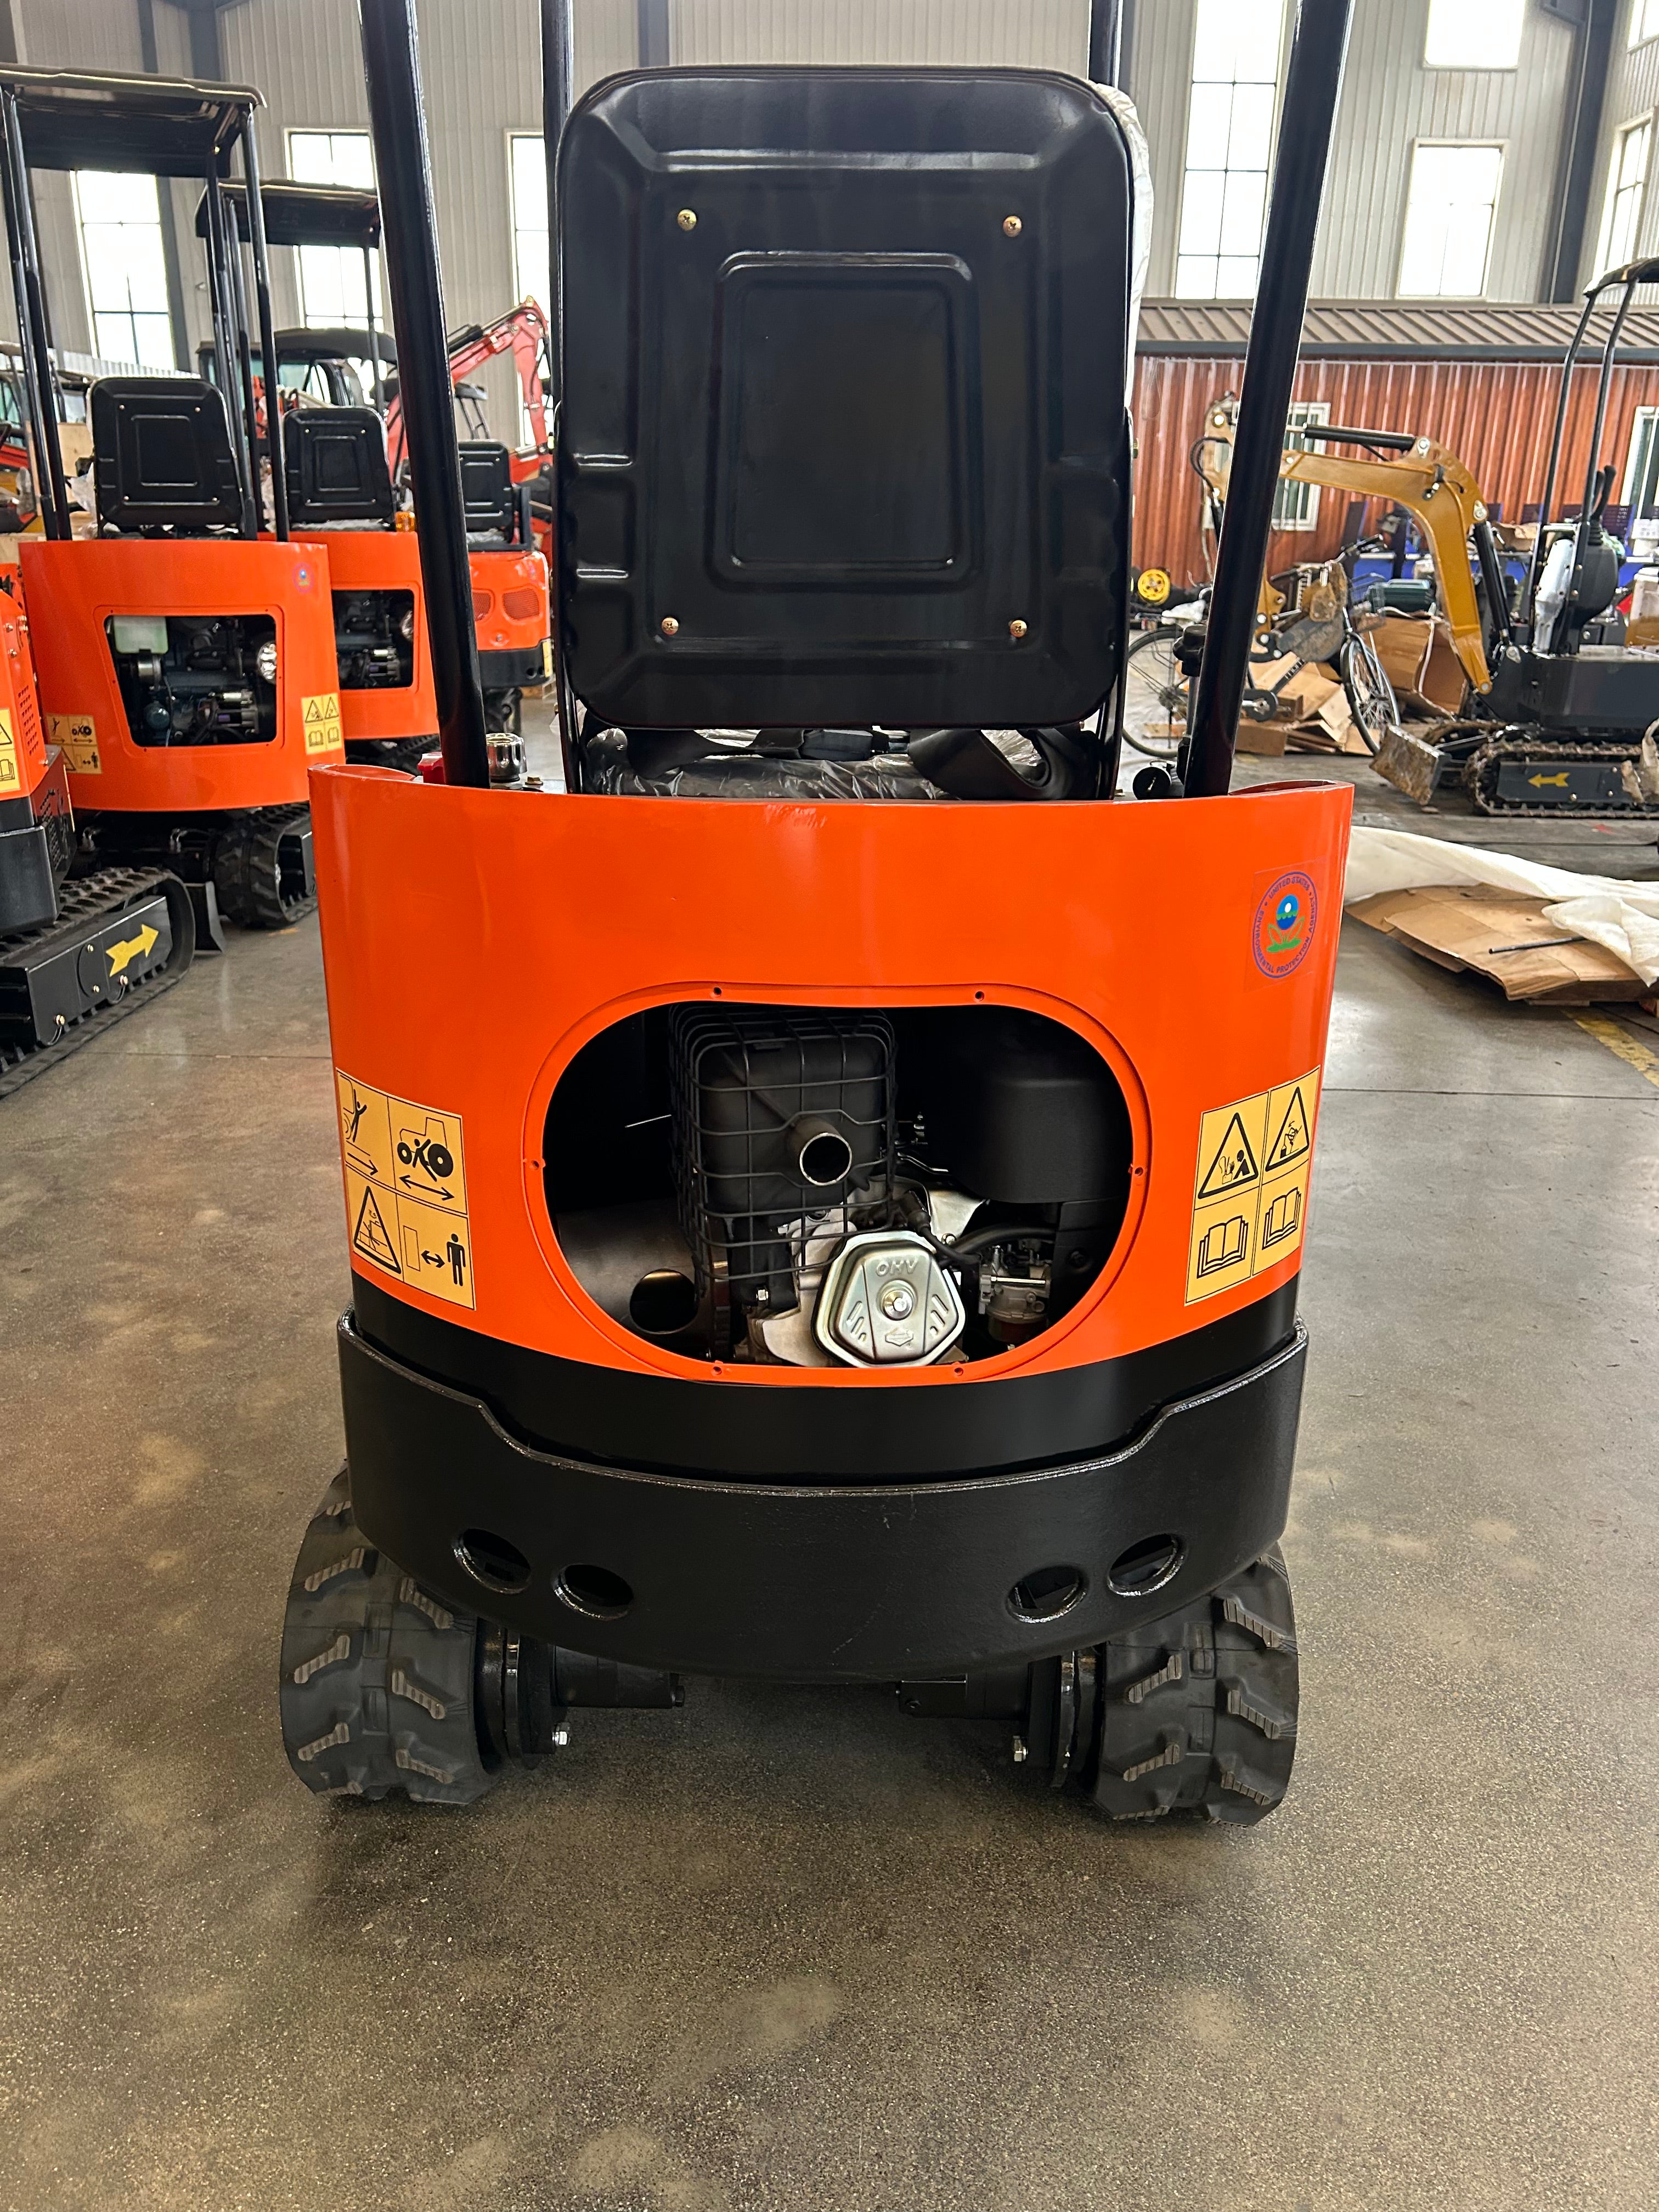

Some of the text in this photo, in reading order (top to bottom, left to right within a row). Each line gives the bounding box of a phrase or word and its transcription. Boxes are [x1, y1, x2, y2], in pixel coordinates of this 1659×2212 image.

[1268, 876, 1310, 899] UNITED STATES
[1255, 910, 1274, 973] ENVIRONMENTAL
[1276, 936, 1310, 974] PROTECTION
[875, 1256, 919, 1277] OHV
